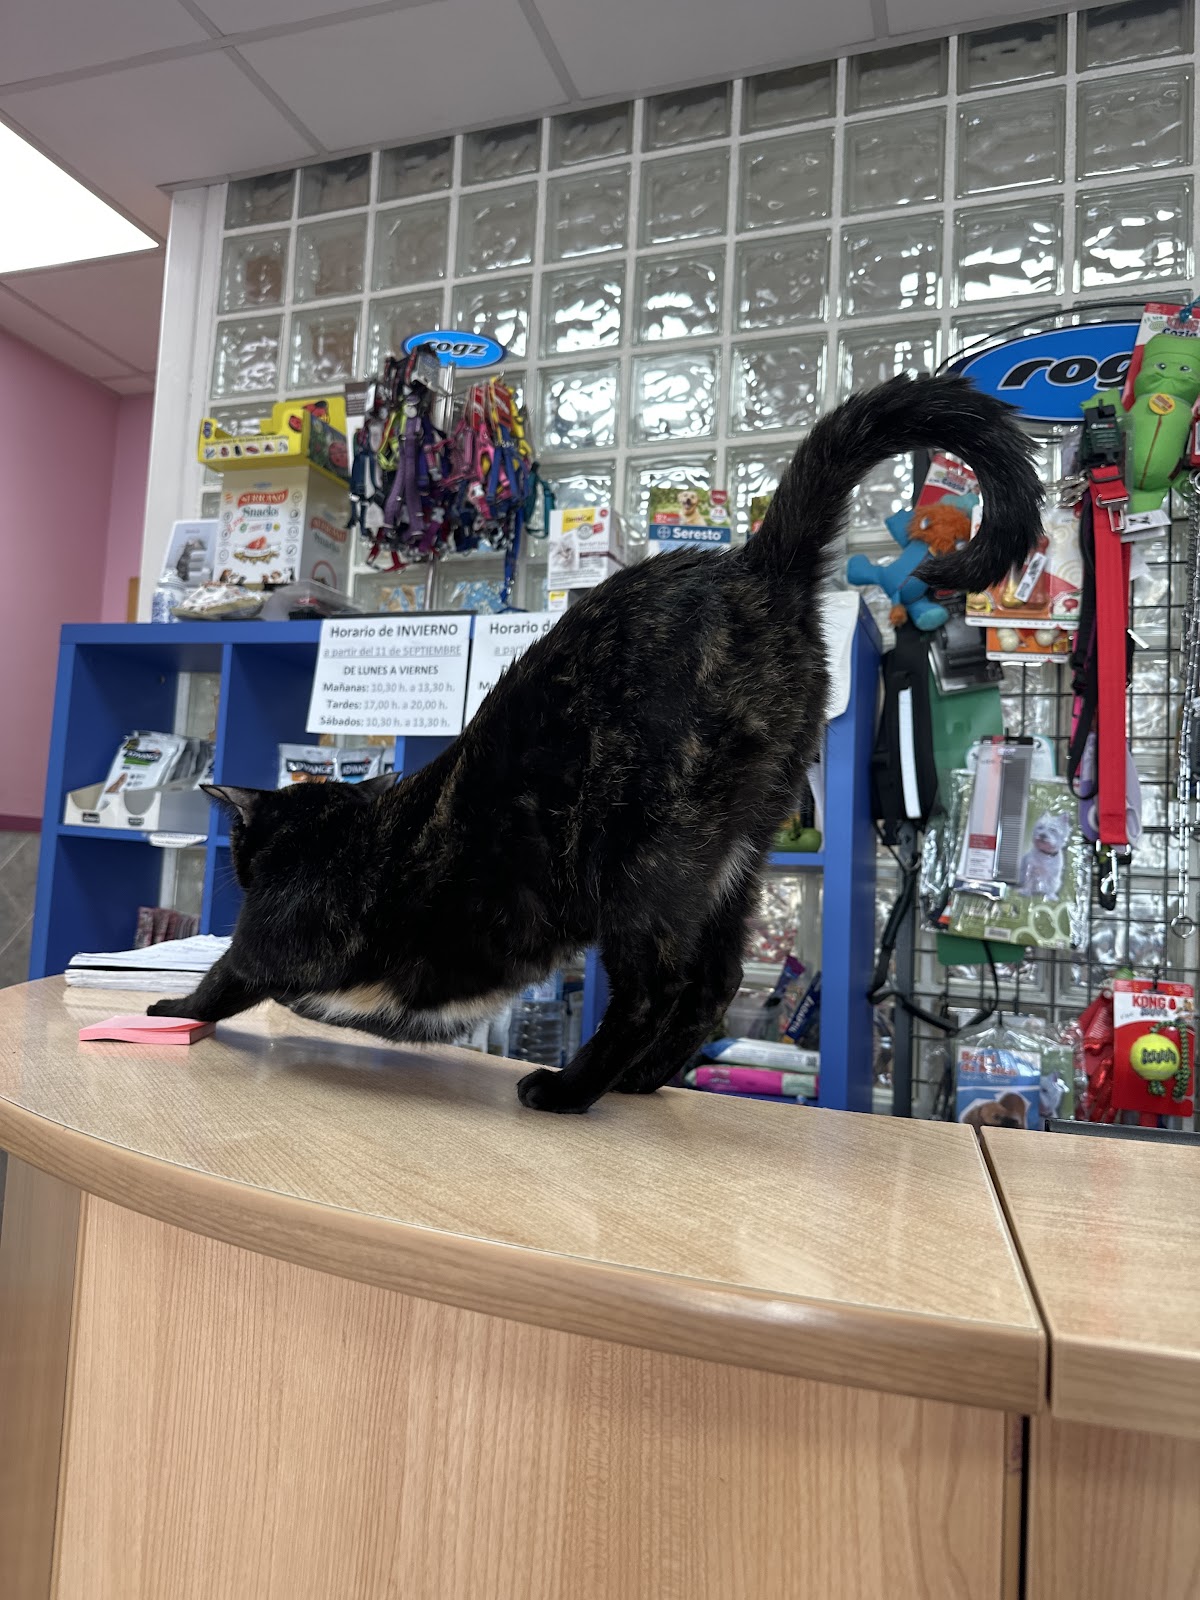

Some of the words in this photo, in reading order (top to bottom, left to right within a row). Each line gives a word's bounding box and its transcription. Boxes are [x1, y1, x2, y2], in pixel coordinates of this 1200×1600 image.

[998, 352, 1133, 390] rog
[672, 526, 722, 541] Seresto
[330, 625, 375, 638] Horario
[378, 625, 394, 637] de
[397, 624, 458, 637] INVIERNO
[490, 621, 538, 634] Horario
[323, 649, 330, 657] a
[332, 647, 357, 658] partir
[359, 647, 374, 656] del
[376, 647, 386, 656] 11
[389, 646, 401, 656] de
[403, 645, 462, 657] SEPTIEMBRE
[343, 666, 355, 676] DE
[358, 666, 388, 676] LUNES
[390, 666, 397, 675] A
[400, 665, 439, 675] VIERNES
[323, 683, 369, 692] Mañanas:
[326, 700, 362, 710] Tardes:
[320, 716, 364, 727] Sábados:
[1132, 994, 1167, 1010] KONG
